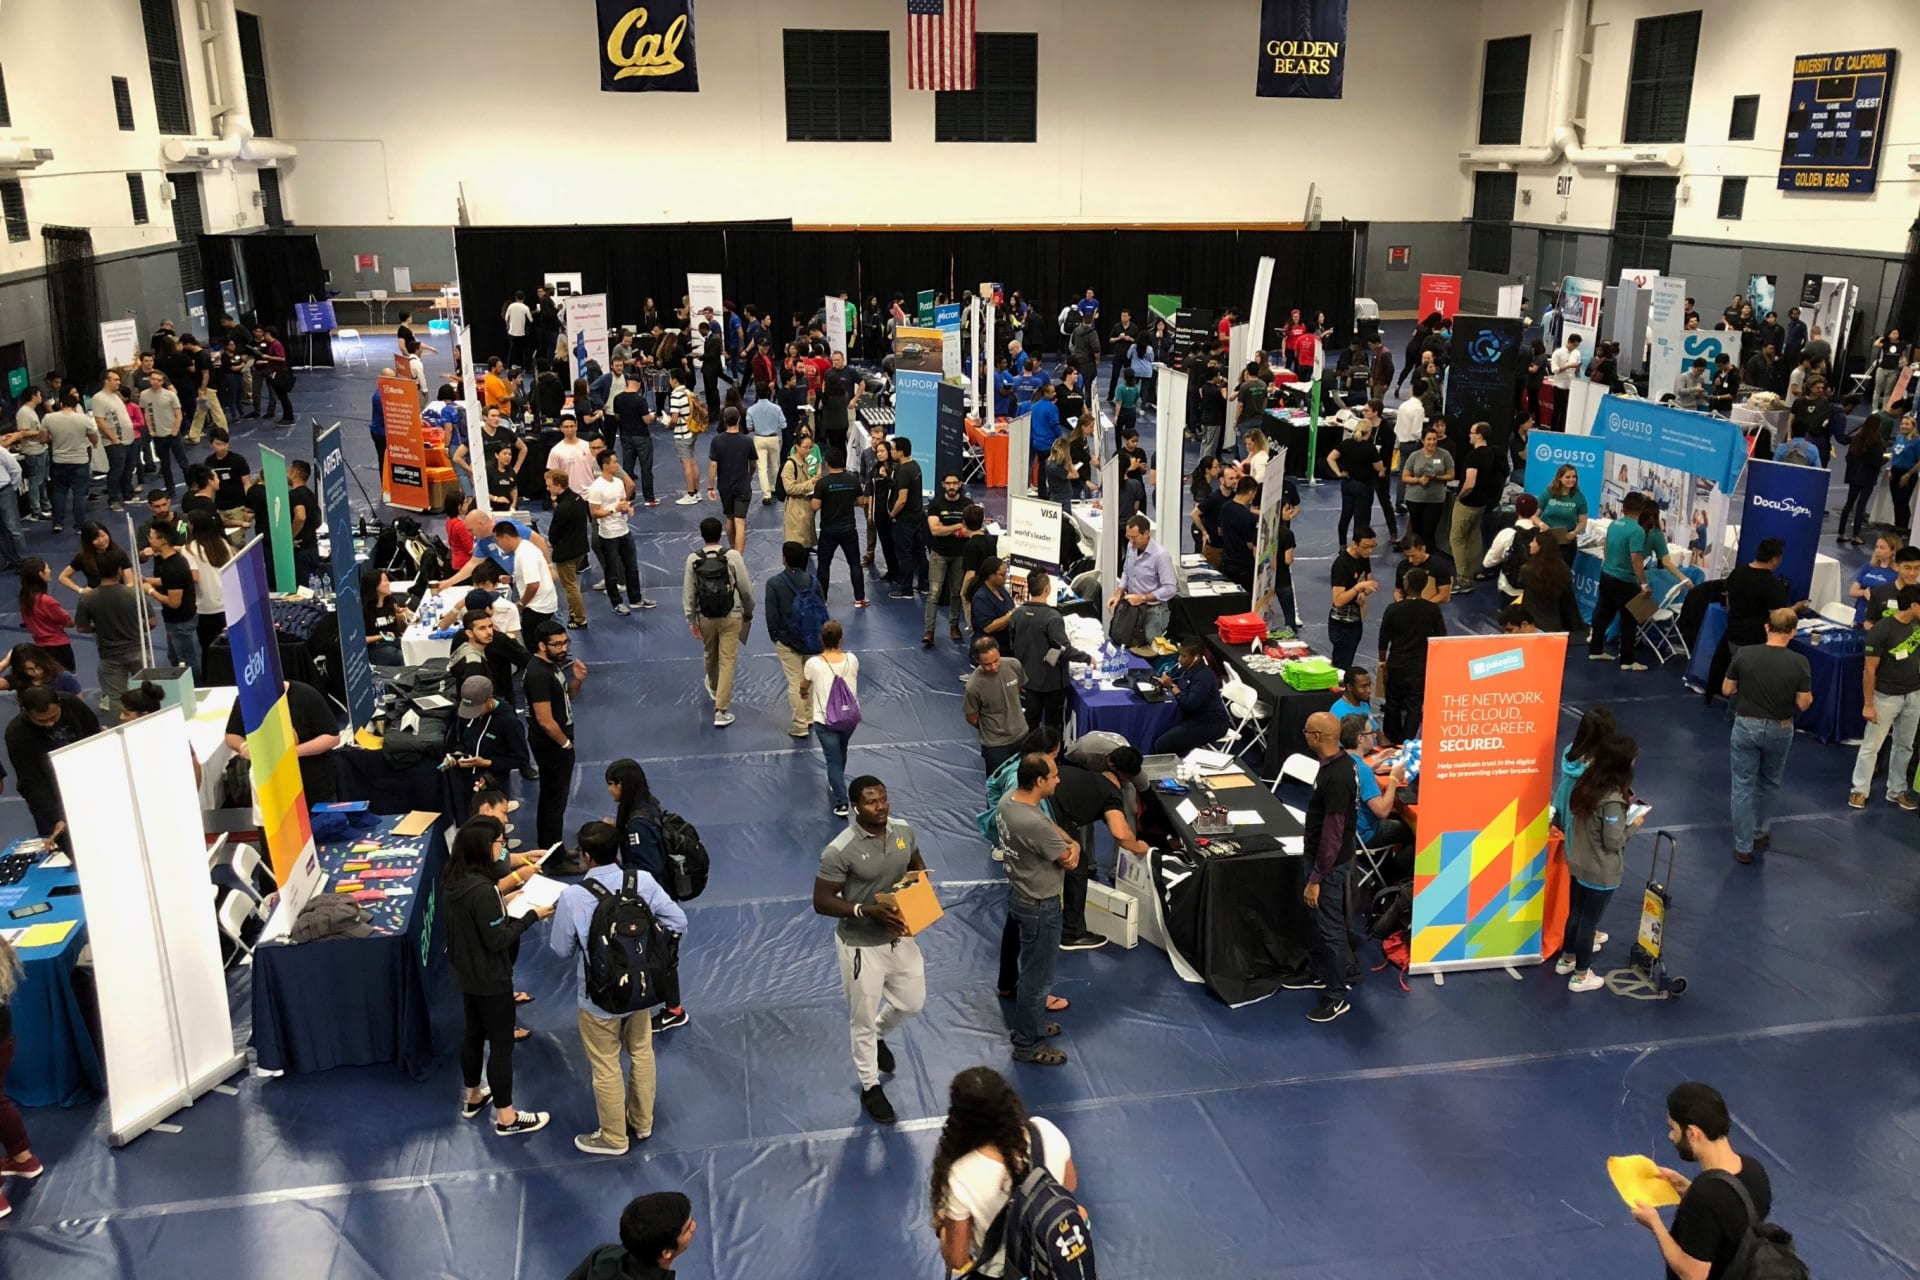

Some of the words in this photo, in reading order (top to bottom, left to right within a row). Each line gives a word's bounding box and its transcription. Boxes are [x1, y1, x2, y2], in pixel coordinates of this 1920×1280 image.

[607, 7, 687, 80] Cal
[1266, 40, 1339, 58] GOLDEN
[1274, 58, 1330, 75] BEARS
[1795, 58, 1832, 74] UNIVERSITY
[1834, 57, 1844, 71] OF
[1846, 53, 1887, 70] CALIFORNIA
[1856, 98, 1880, 109] GUEST
[1795, 172, 1823, 187] GOLDEN
[1825, 173, 1850, 188] BEARS
[898, 378, 938, 391] AURORA
[1621, 418, 1653, 435] GUSTO
[1554, 448, 1596, 463] GUSTO
[1041, 508, 1058, 520] VISA
[1014, 529, 1034, 538] world's
[1034, 532, 1052, 542] leader
[244, 645, 265, 686] ebay
[1442, 694, 1470, 707] THE
[1441, 709, 1469, 722] THE
[1440, 724, 1479, 737] YOUR
[1481, 720, 1537, 735] CAREER.
[1439, 737, 1505, 752] SECURED.
[1437, 762, 1452, 770] Help
[1453, 761, 1481, 769] maintain
[1515, 758, 1537, 766] digital
[1457, 770, 1491, 778] preventing
[421, 877, 435, 967] ebay
